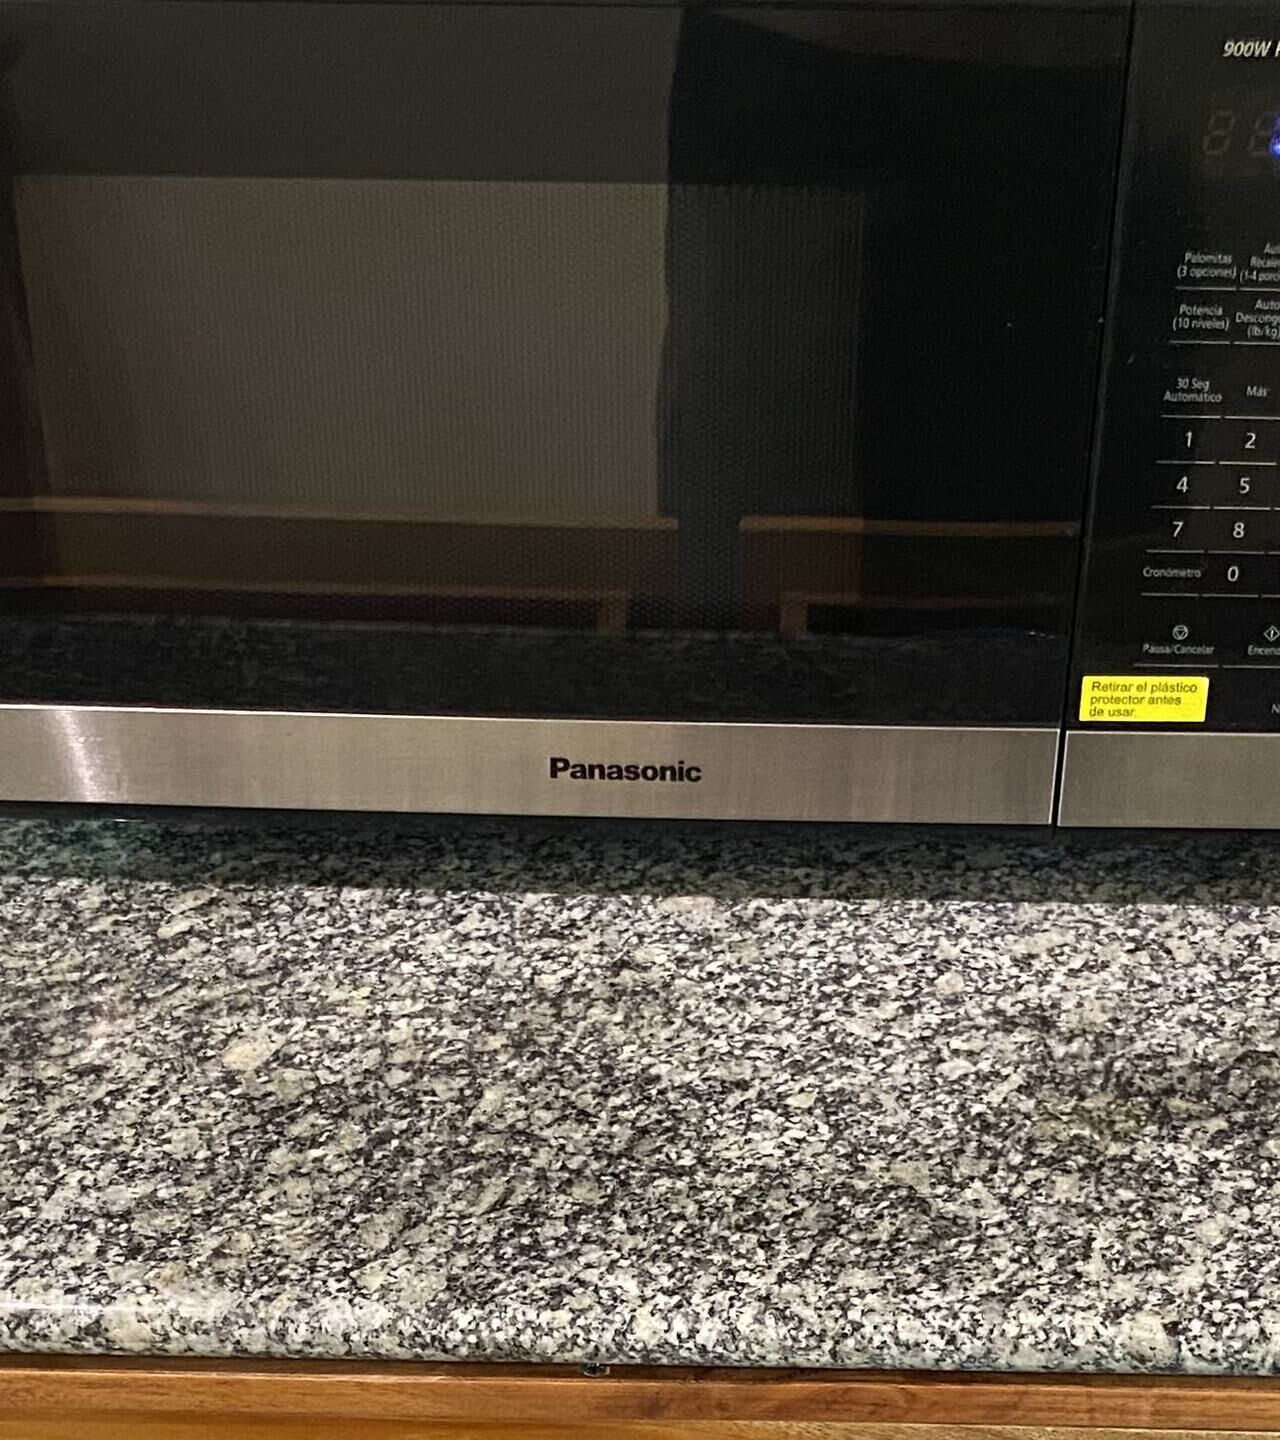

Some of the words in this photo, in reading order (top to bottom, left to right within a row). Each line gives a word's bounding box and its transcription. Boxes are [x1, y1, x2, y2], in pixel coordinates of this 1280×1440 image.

[1223, 40, 1272, 58] 900W
[1184, 252, 1232, 264] Palomitas
[1177, 265, 1188, 279] (3
[1179, 303, 1223, 316] Potencia
[1254, 299, 1280, 310] Auto
[1173, 316, 1190, 331] (10
[1191, 316, 1230, 331] niveles)
[1176, 378, 1189, 389] 30
[1191, 377, 1210, 392] Seg
[1246, 385, 1268, 397] Más
[1185, 431, 1193, 448] 1
[1244, 432, 1257, 449] 2
[1176, 476, 1189, 493] 4
[1239, 477, 1251, 494] 5
[1172, 521, 1184, 538] 7
[1233, 522, 1245, 539] 8
[1227, 566, 1239, 582] 0
[1091, 681, 1134, 693] Retirar
[1136, 681, 1147, 693] el
[1150, 681, 1198, 695] plástico
[1090, 694, 1145, 706] protector
[1148, 695, 1182, 706] antes
[1089, 706, 1104, 718] de
[549, 757, 702, 782] Panasonic
